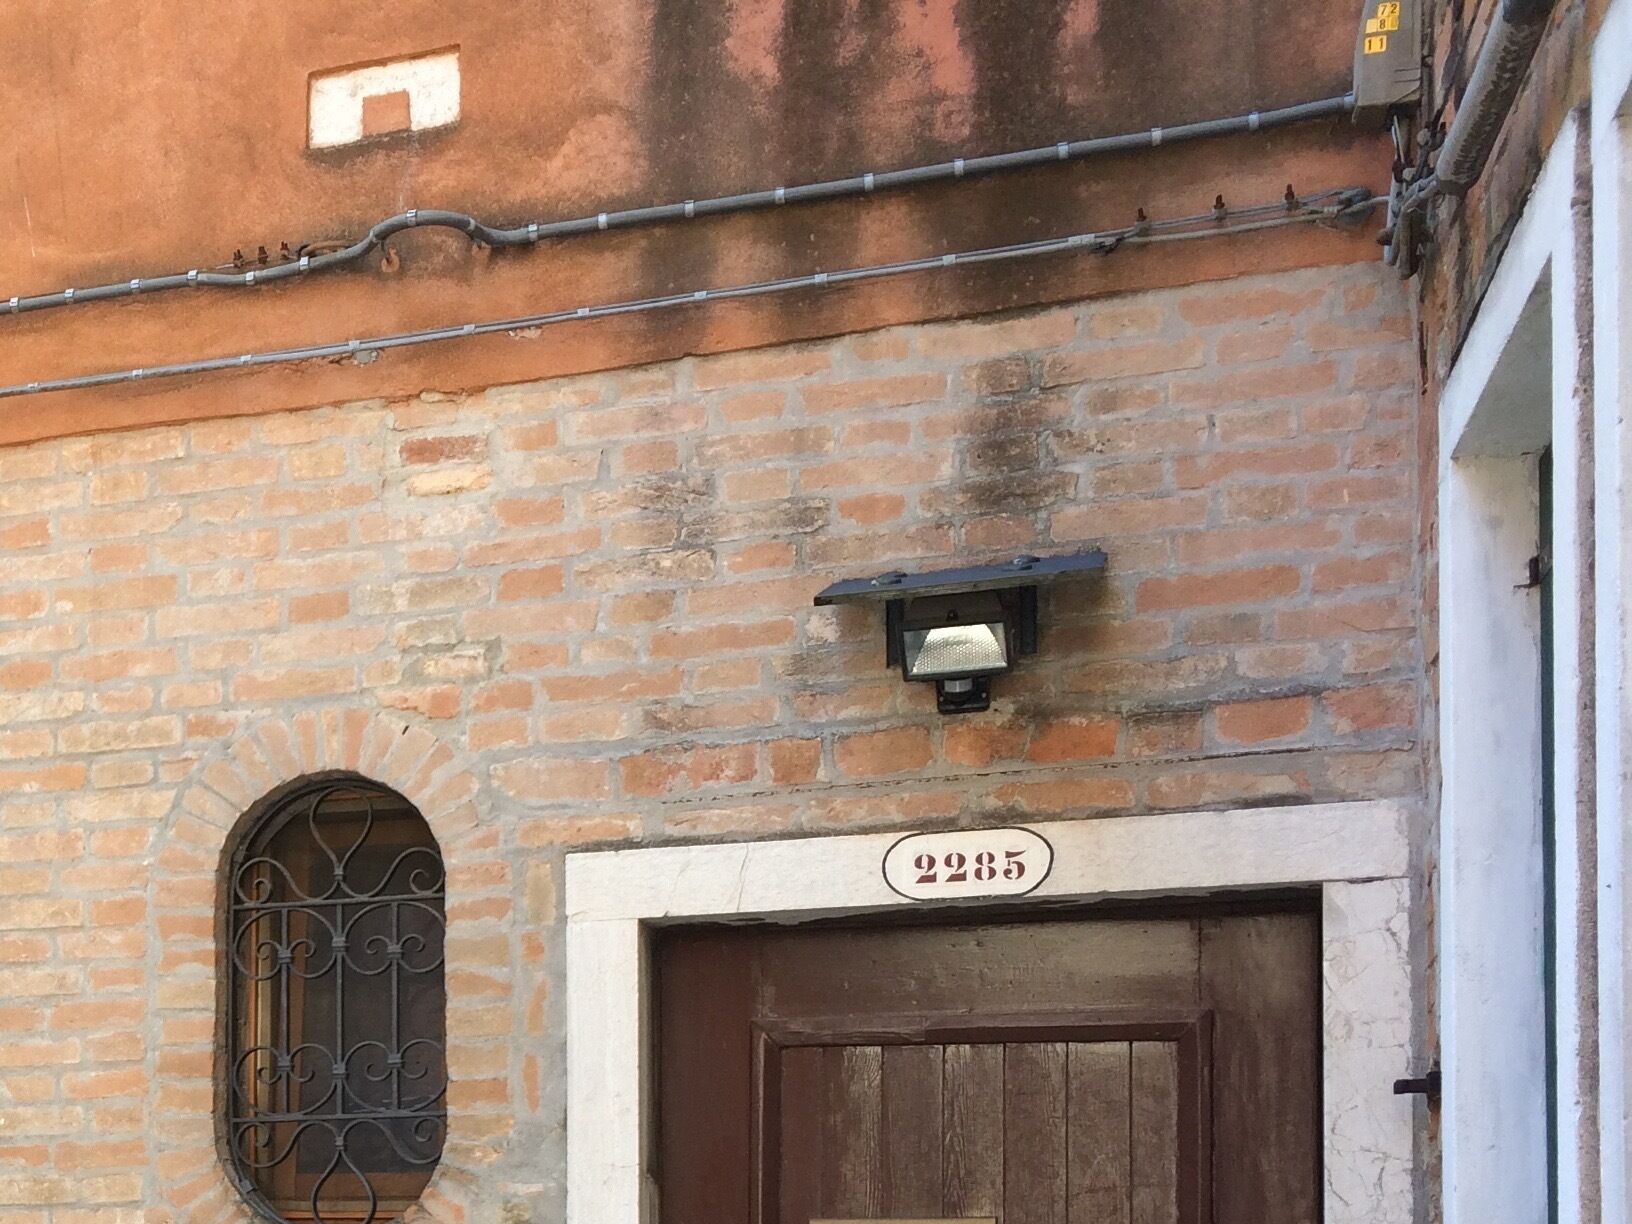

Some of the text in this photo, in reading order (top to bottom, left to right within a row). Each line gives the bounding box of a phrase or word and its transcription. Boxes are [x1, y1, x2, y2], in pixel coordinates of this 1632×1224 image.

[1380, 3, 1398, 15] 72
[1367, 37, 1384, 51] 11
[913, 849, 1027, 884] 2285
